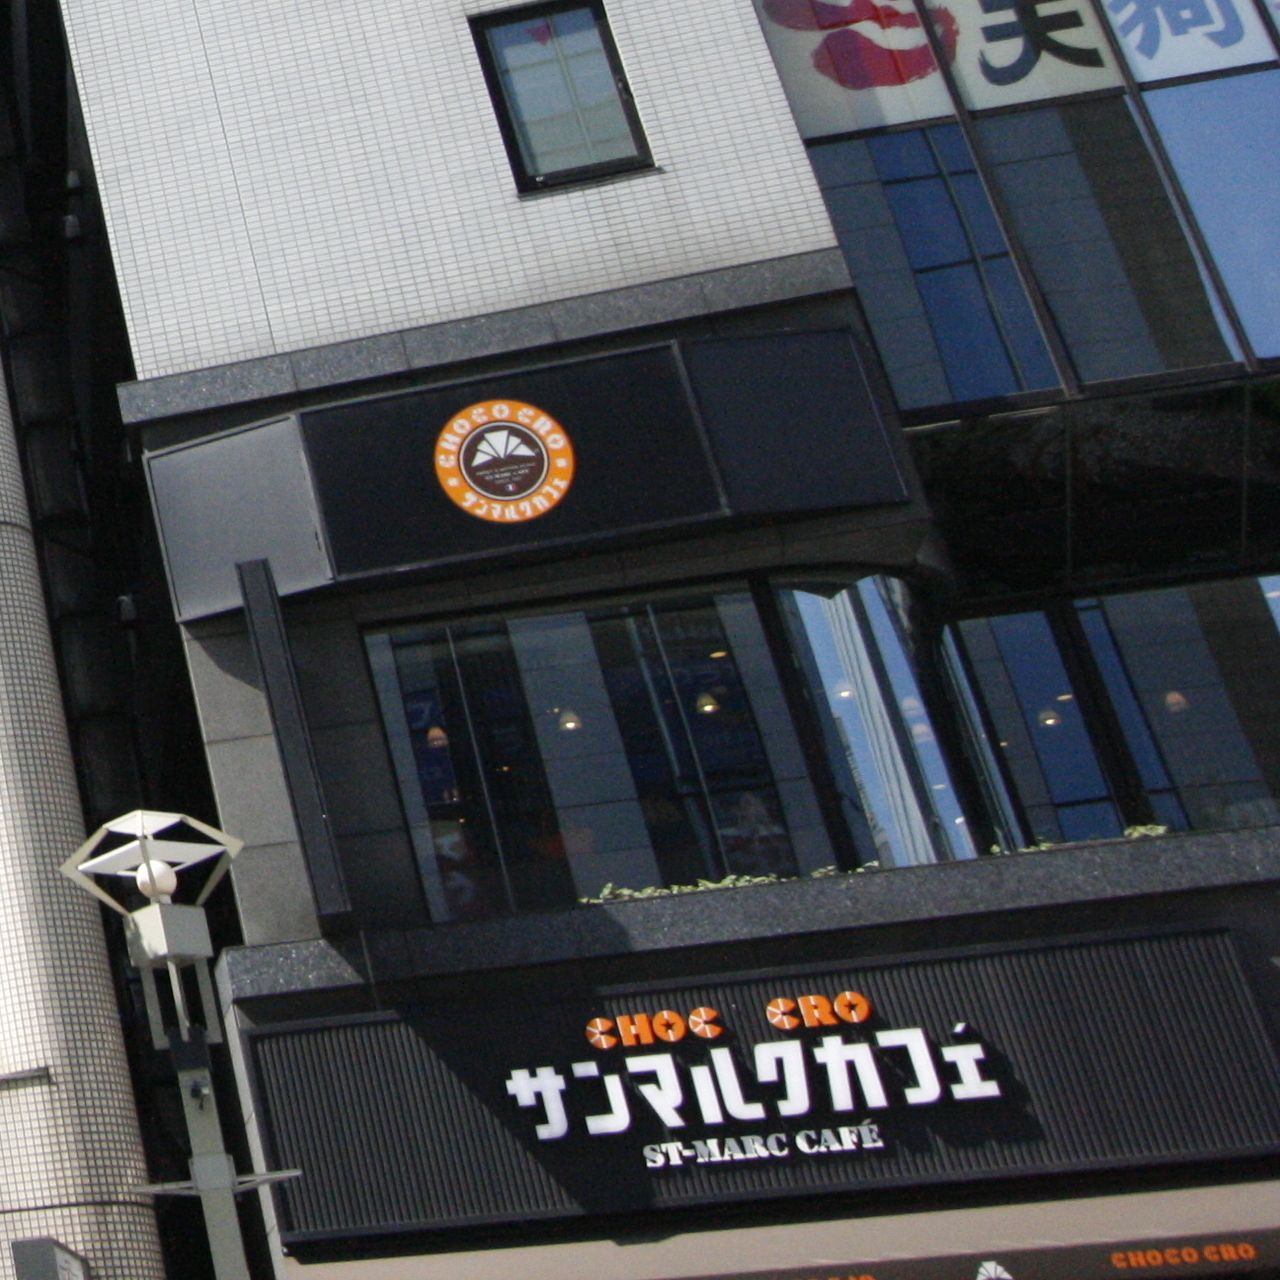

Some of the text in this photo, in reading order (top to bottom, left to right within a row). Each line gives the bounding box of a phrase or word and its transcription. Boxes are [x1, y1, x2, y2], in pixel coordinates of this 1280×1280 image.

[439, 403, 510, 467] CHOCO
[766, 991, 871, 1030] CRO
[505, 1022, 1001, 1140] サンマルクカフェ
[643, 1133, 789, 1169] ST-MARC
[1110, 1243, 1257, 1269] CHOCO CRO
